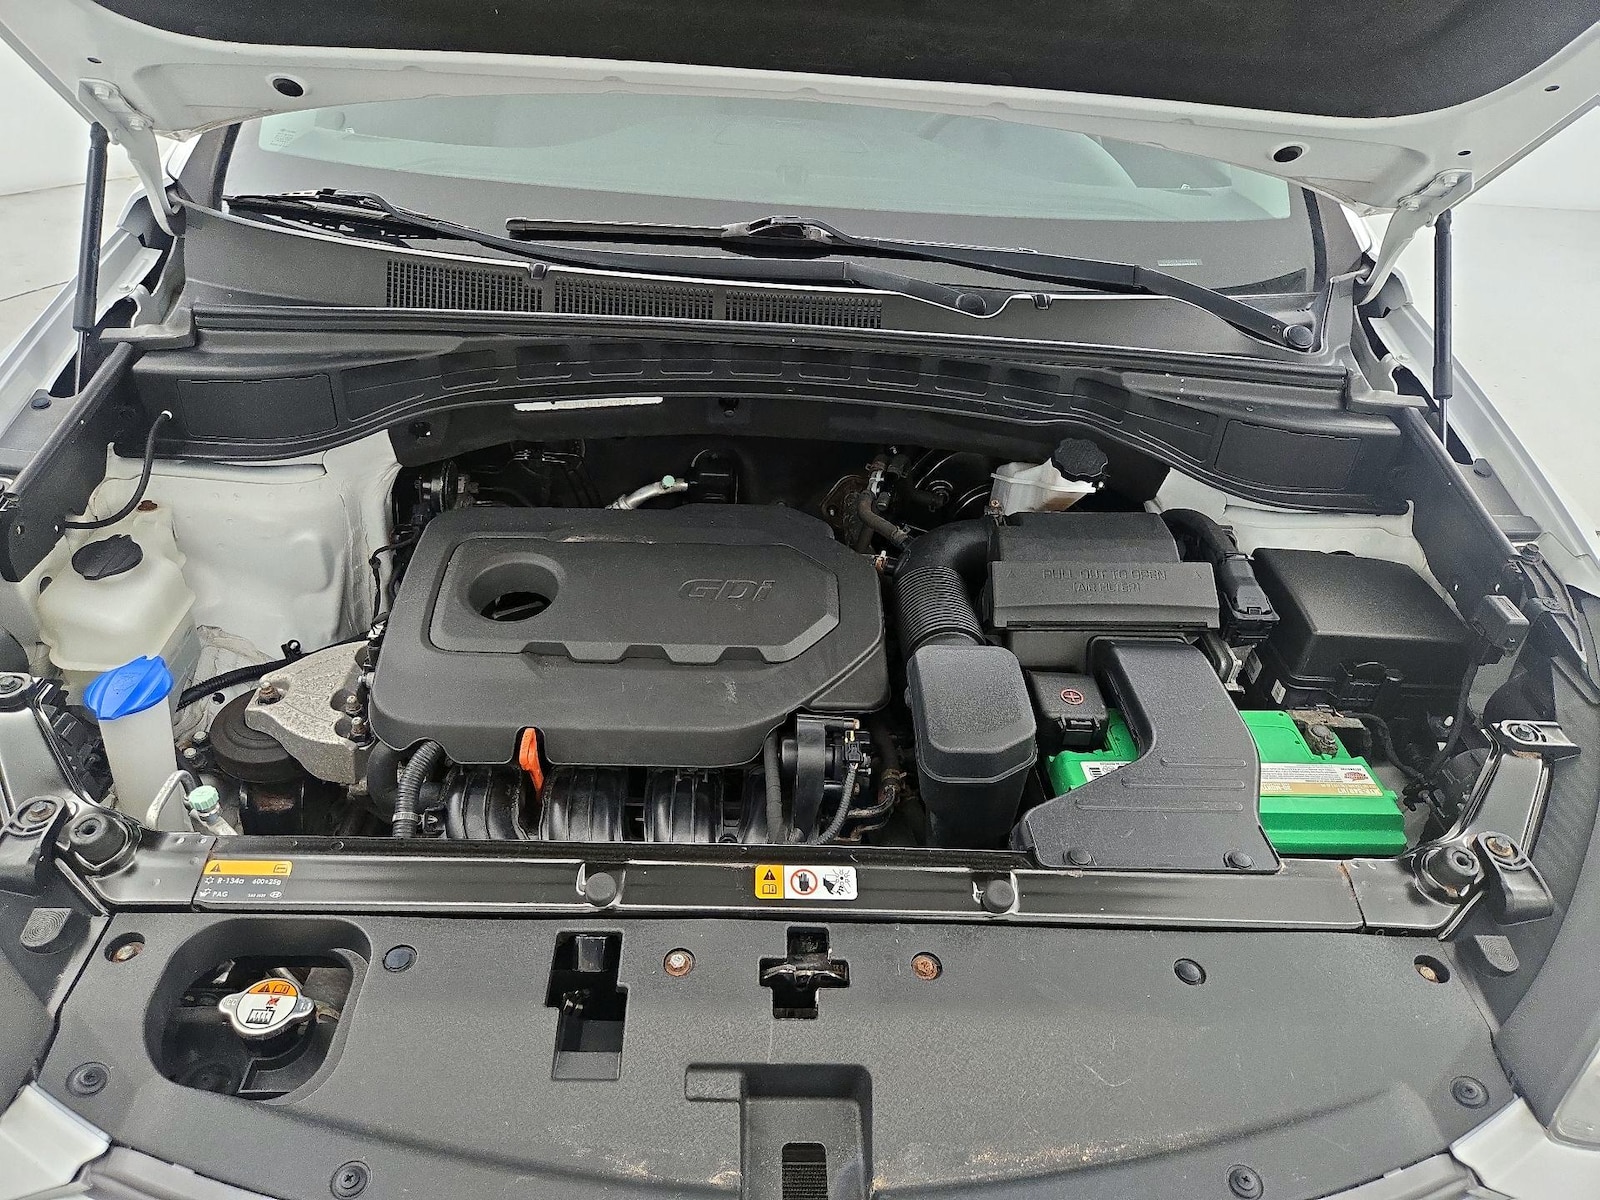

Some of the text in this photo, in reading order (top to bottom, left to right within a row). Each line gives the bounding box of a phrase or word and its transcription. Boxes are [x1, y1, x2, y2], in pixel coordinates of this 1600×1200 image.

[1041, 568, 1168, 581] PULL OUT TO OPEN
[678, 578, 776, 602] GDi
[216, 876, 245, 885] R-134a
[212, 890, 229, 898] PAG
